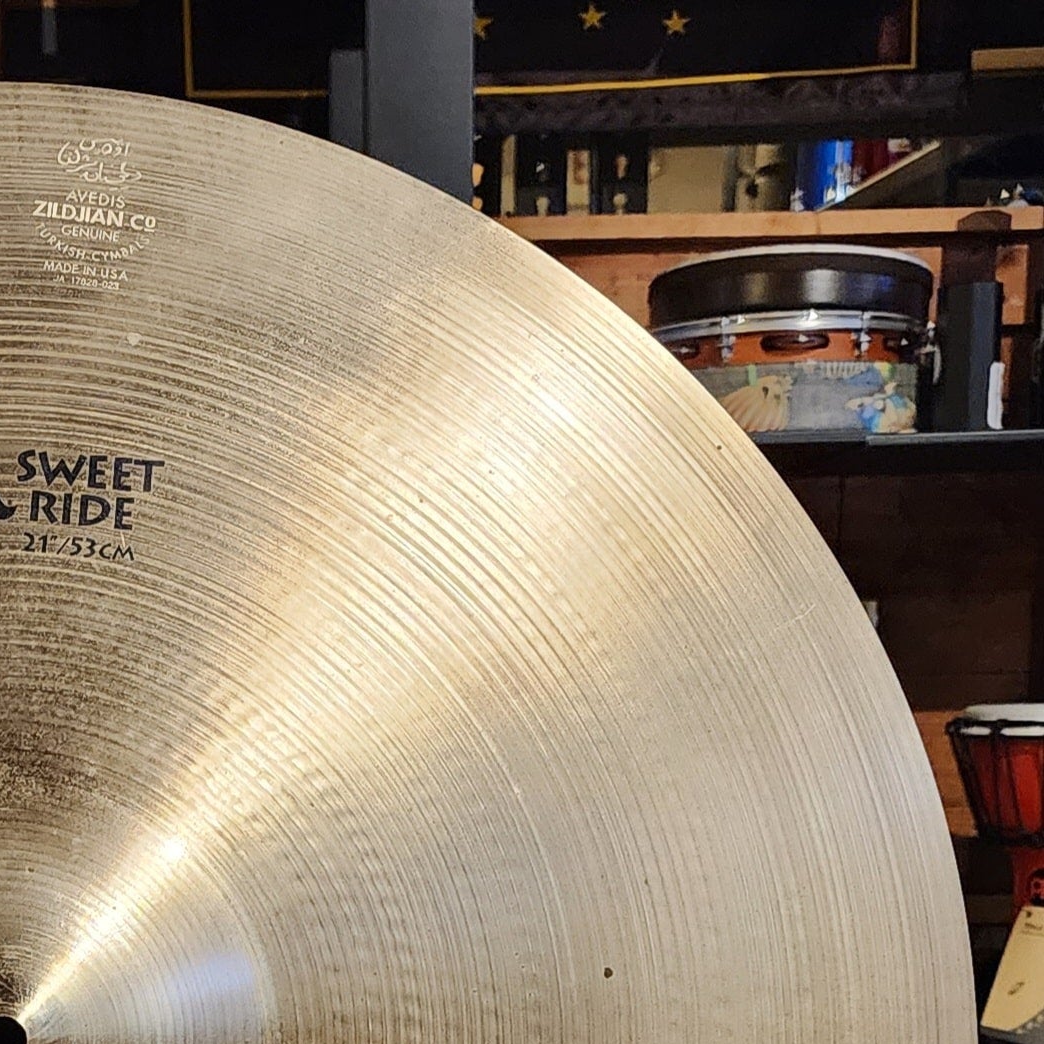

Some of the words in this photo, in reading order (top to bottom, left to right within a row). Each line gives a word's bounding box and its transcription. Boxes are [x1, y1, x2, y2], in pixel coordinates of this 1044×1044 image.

[66, 189, 126, 209] AVEDIS
[32, 200, 124, 227] ZILDJIAN
[35, 222, 86, 260] TURKISH
[91, 235, 150, 261] CYMBALS
[61, 225, 120, 242] GENUINE
[43, 260, 80, 274] MADE
[83, 264, 97, 276] IN
[100, 267, 129, 282] USA
[17, 449, 166, 493] SWEET
[29, 490, 135, 531] RIDE
